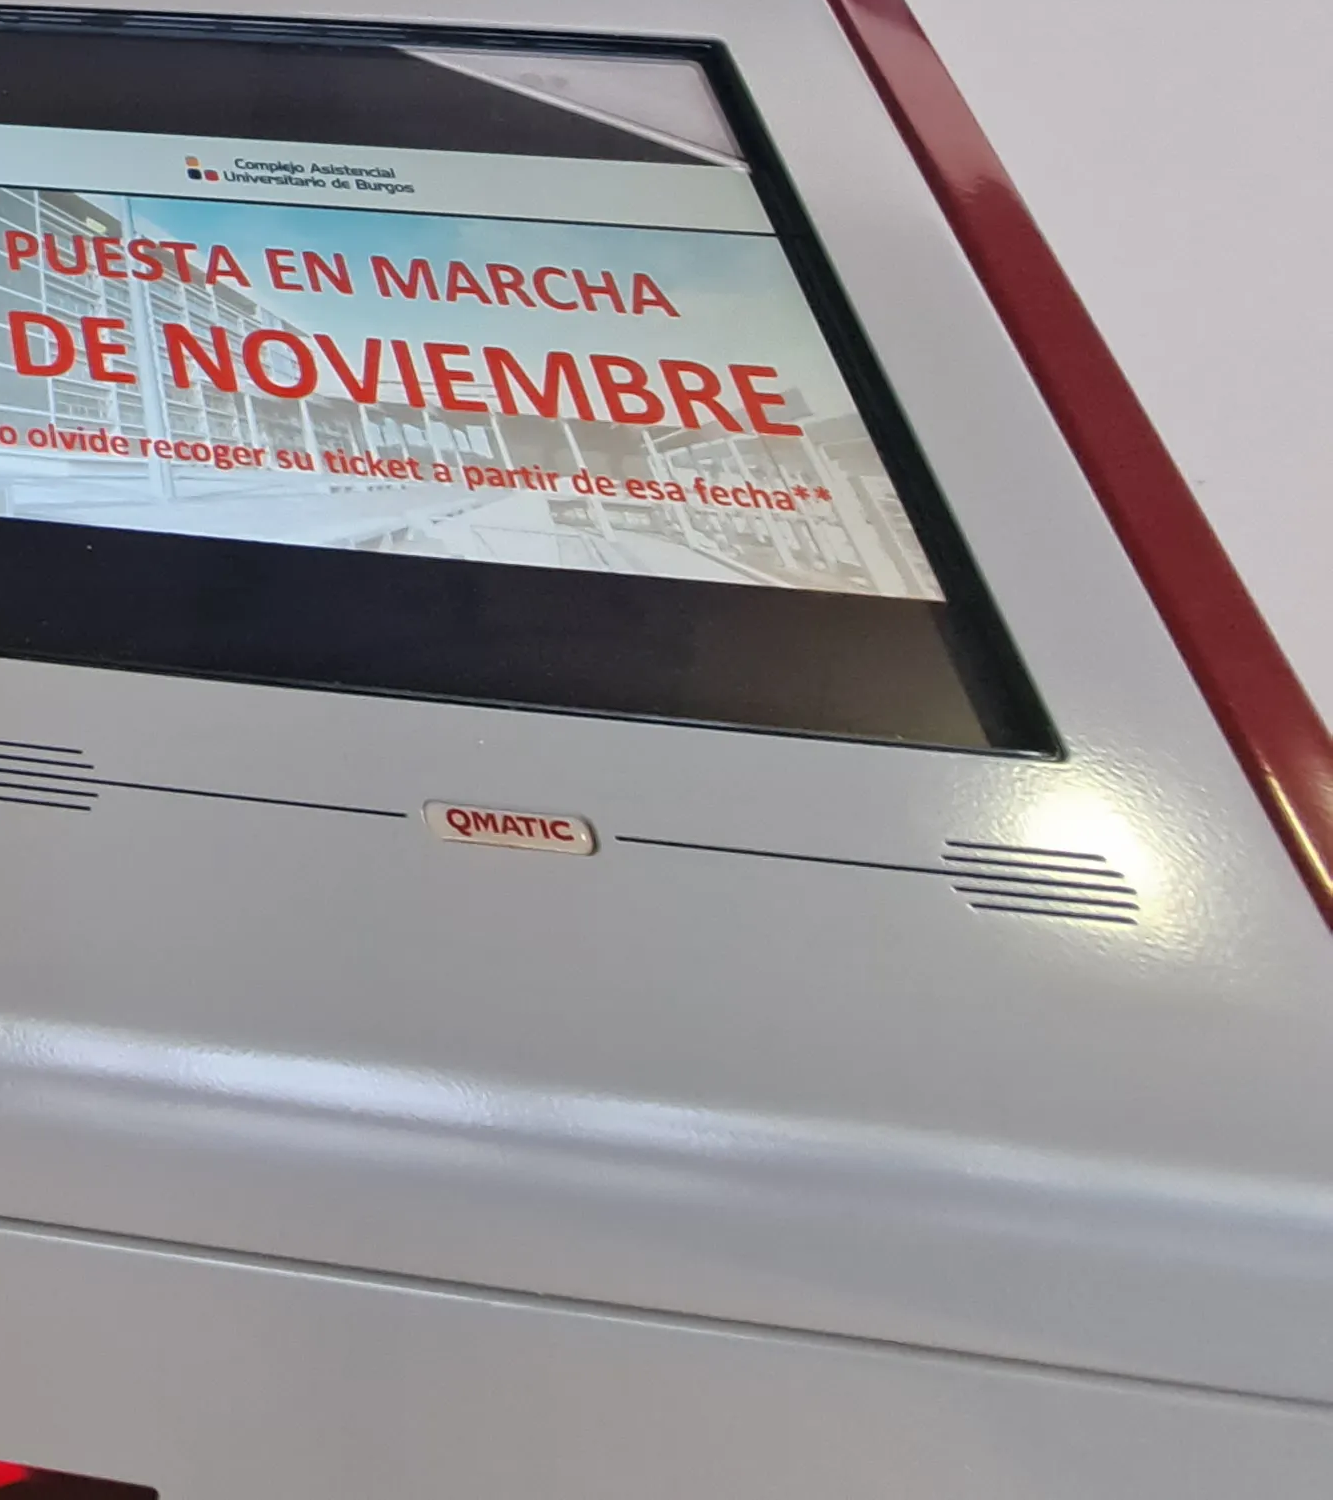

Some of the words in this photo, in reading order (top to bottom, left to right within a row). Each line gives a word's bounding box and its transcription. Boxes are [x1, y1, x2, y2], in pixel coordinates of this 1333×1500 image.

[223, 170, 326, 189] Universitario
[331, 177, 350, 190] de
[355, 178, 415, 195] Burgos
[234, 158, 305, 175] Complejo
[310, 161, 396, 179] Asistencial
[4, 229, 252, 288] PUESTA
[263, 247, 355, 296] EN
[369, 255, 681, 318] MARCHA
[7, 310, 136, 385] DE
[162, 322, 804, 437] NOVIEMBRE
[27, 423, 129, 456] olvide
[139, 437, 266, 470] recoger
[277, 448, 314, 472] su
[322, 447, 424, 481] ticket
[432, 460, 454, 483] a
[461, 456, 559, 491] partir
[571, 467, 616, 497] de
[625, 476, 686, 502] esa
[445, 808, 575, 841] QMATIC
